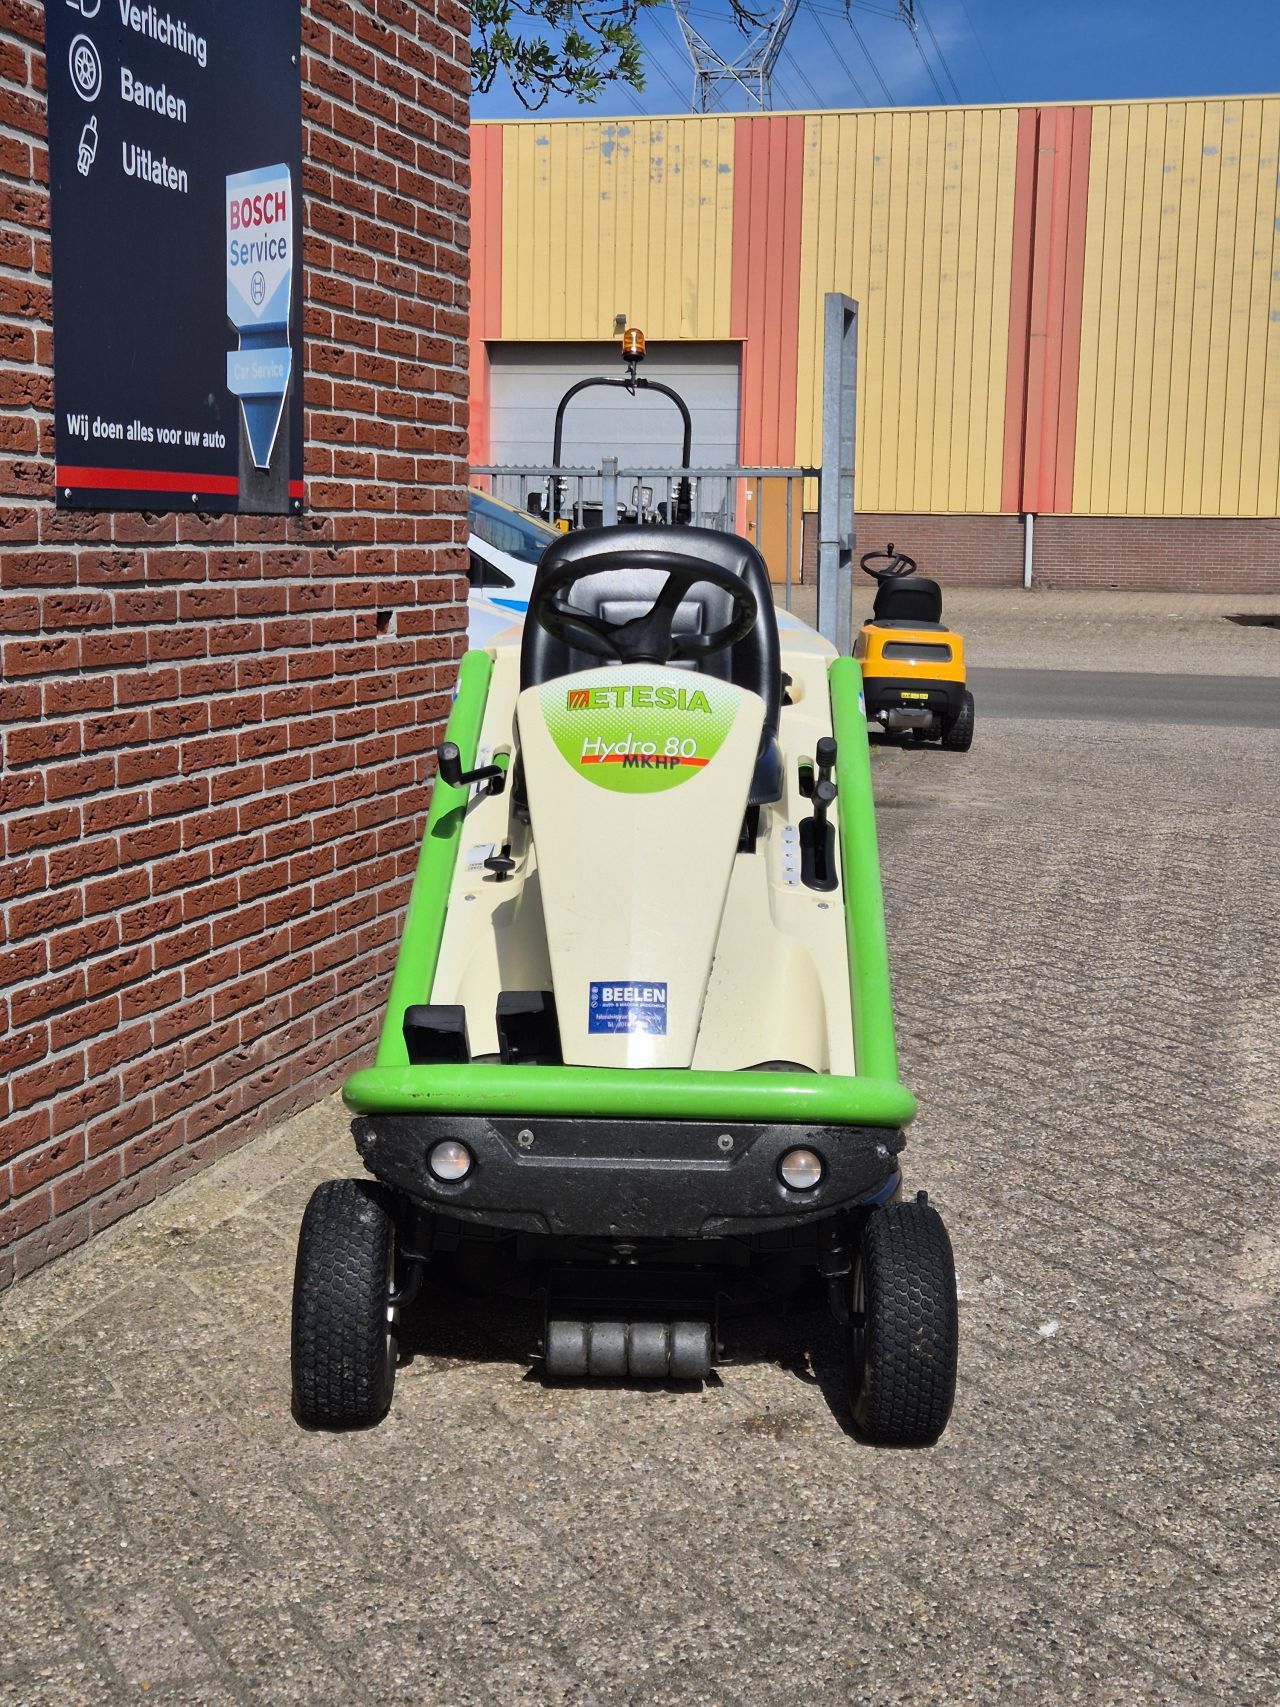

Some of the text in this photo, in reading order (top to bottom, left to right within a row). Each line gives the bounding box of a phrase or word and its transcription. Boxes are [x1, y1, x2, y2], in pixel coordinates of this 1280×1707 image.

[119, 0, 207, 68] Verlichting
[120, 66, 187, 123] Banden
[122, 141, 188, 193] Uitlaten
[230, 191, 286, 230] BOSCH
[230, 233, 287, 266] Service
[234, 360, 284, 380] Car Service
[67, 414, 226, 448] Wij doen alles voor uw auto
[588, 686, 712, 713] ETESIA
[582, 733, 697, 762] Hydro 80
[622, 755, 680, 770] MKHP
[602, 987, 666, 1003] BEELEN
